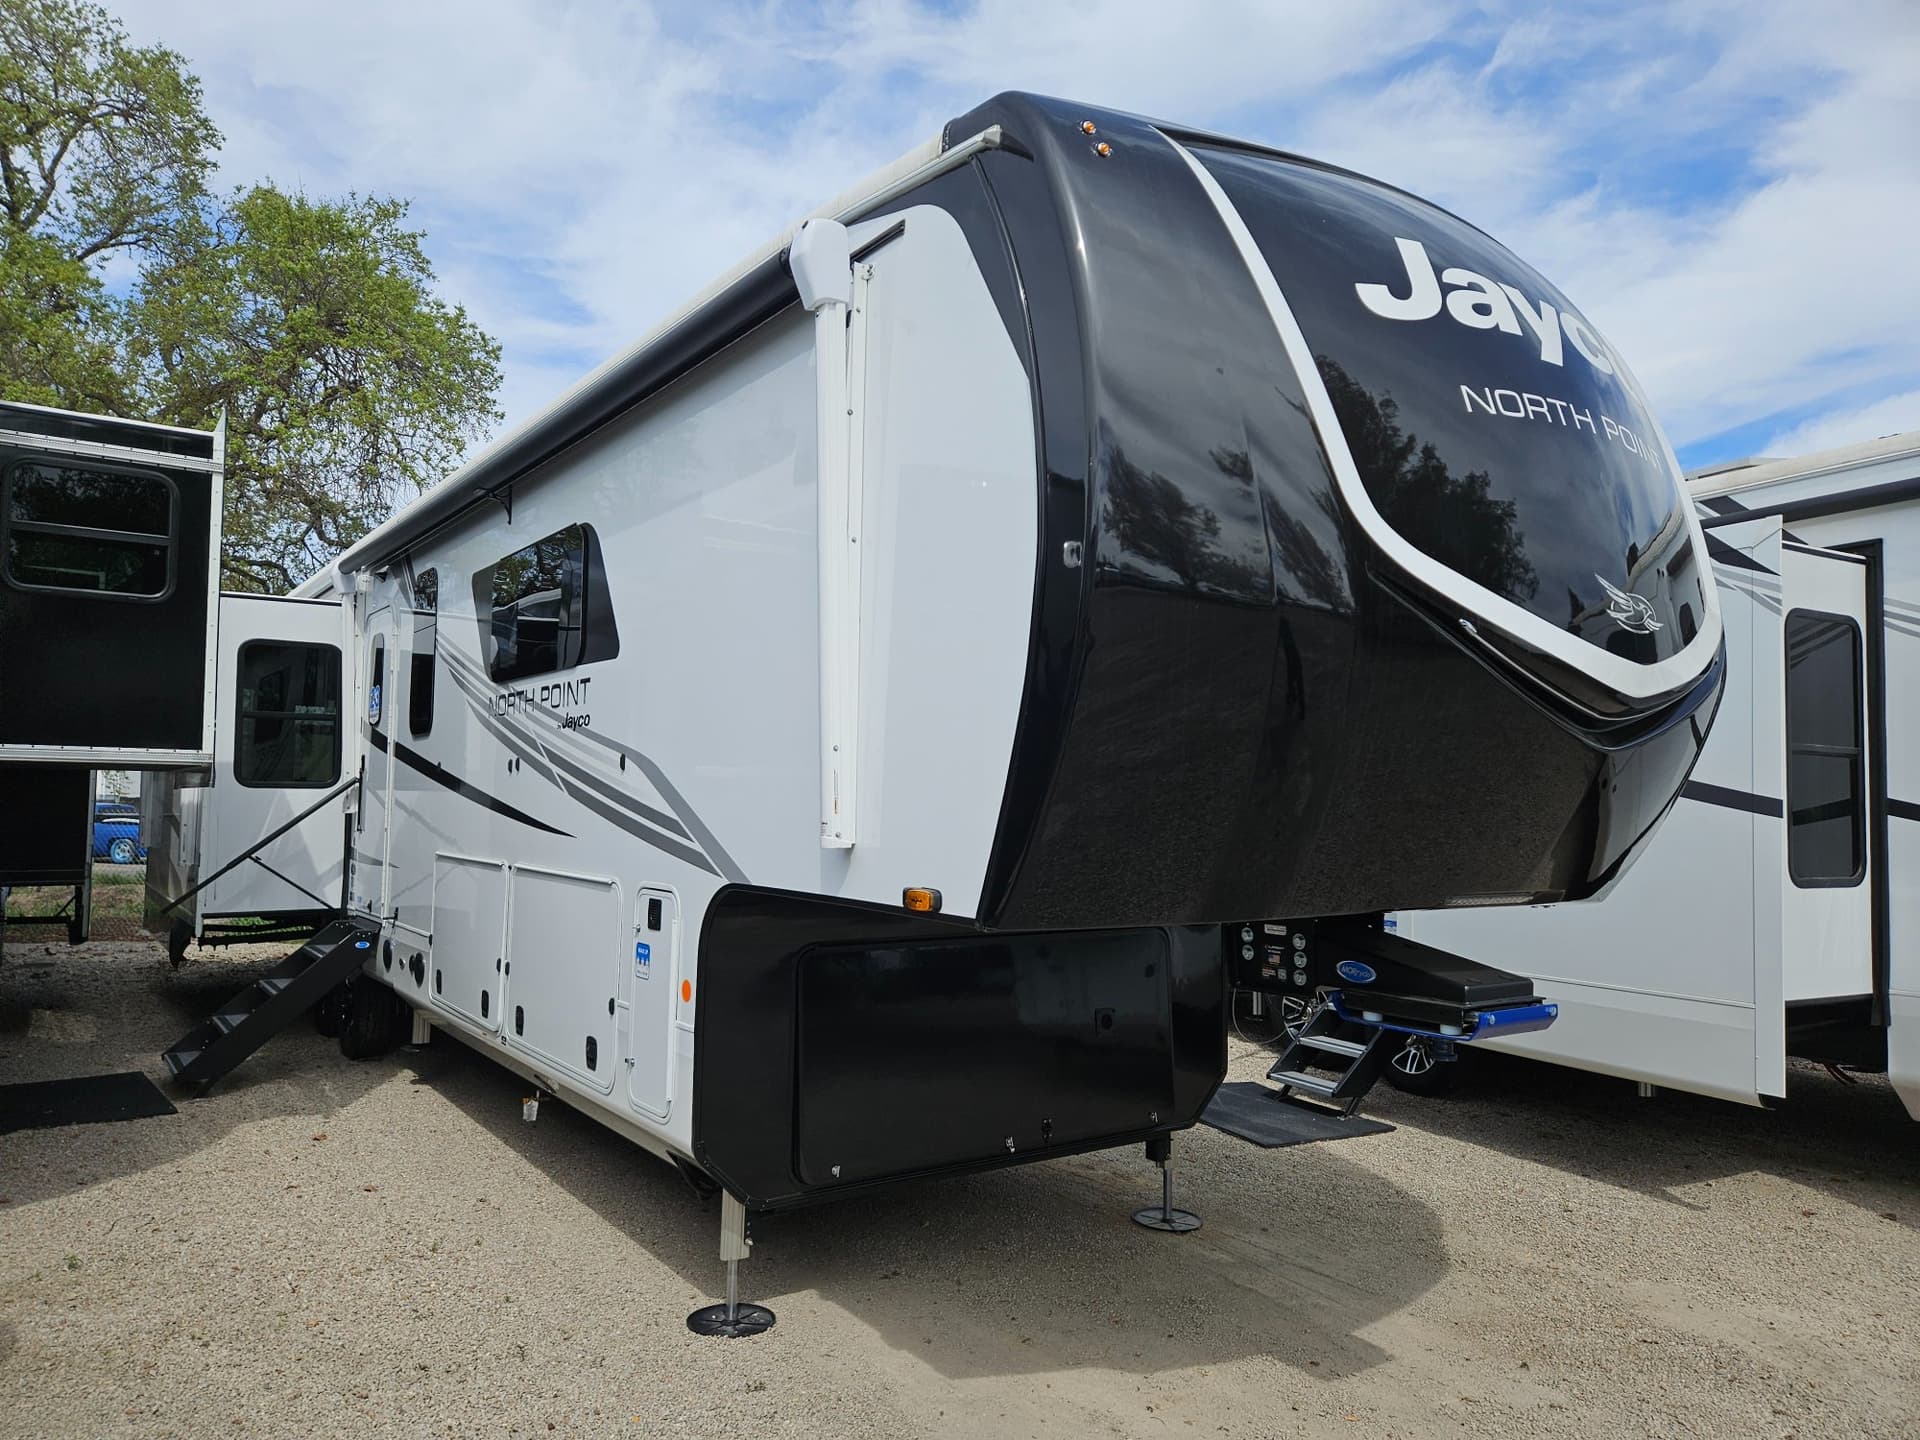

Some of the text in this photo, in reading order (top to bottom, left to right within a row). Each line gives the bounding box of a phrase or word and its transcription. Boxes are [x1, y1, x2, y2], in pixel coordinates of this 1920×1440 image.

[1460, 384, 1597, 434] NORTH
[488, 677, 591, 718] NORTH POINT
[562, 712, 591, 731] Jayco
